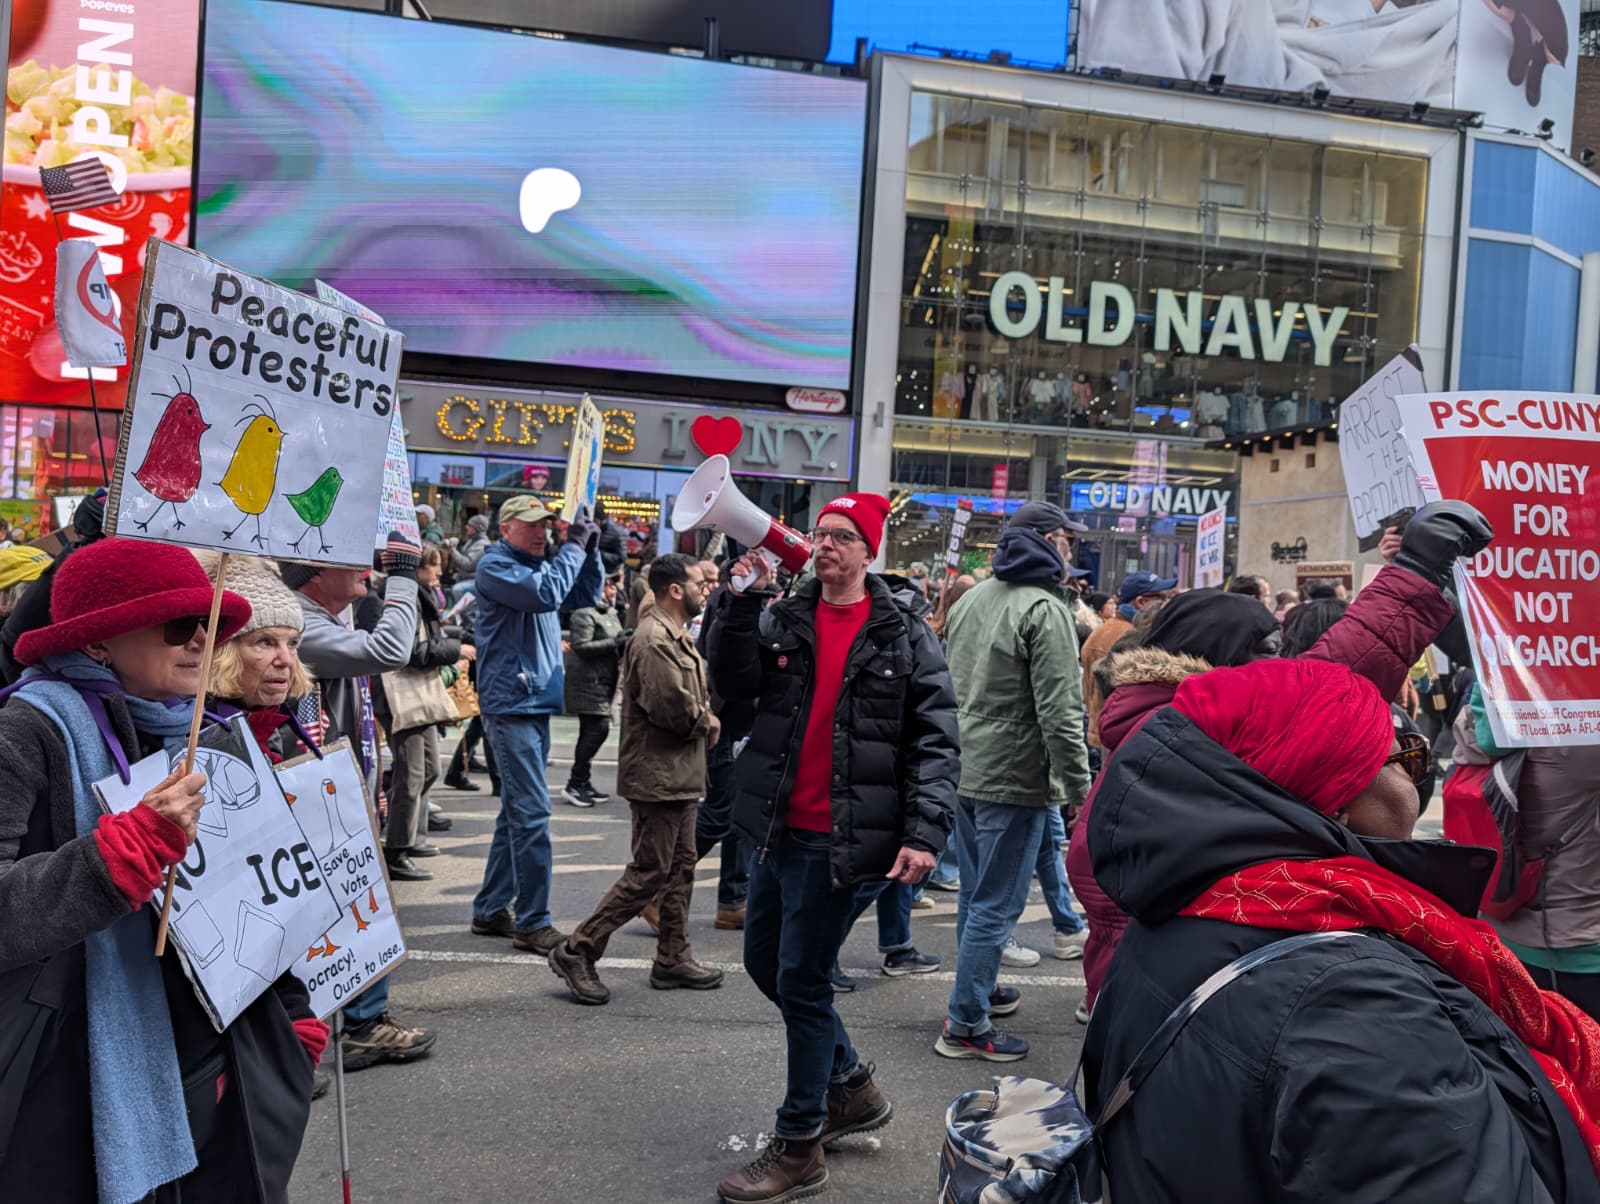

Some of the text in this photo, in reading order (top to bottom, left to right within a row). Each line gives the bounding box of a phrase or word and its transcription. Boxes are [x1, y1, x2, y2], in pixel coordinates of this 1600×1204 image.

[211, 272, 391, 372] Peaceful
[989, 270, 1350, 367] OLD NAVY
[150, 303, 393, 416] Protesters
[662, 412, 687, 458] I
[1366, 437, 1403, 478] THE
[1480, 460, 1590, 495] MONEY
[1089, 481, 1231, 514] OLD NAVY
[1513, 503, 1571, 537] FOR
[1514, 591, 1573, 623] NOT
[1529, 723, 1549, 736] Local
[1551, 722, 1571, 735] 2334
[247, 842, 322, 905] ICE
[323, 846, 375, 877] Save OUR
[341, 874, 370, 896] Vote
[333, 943, 402, 1000] Ours to lose.
